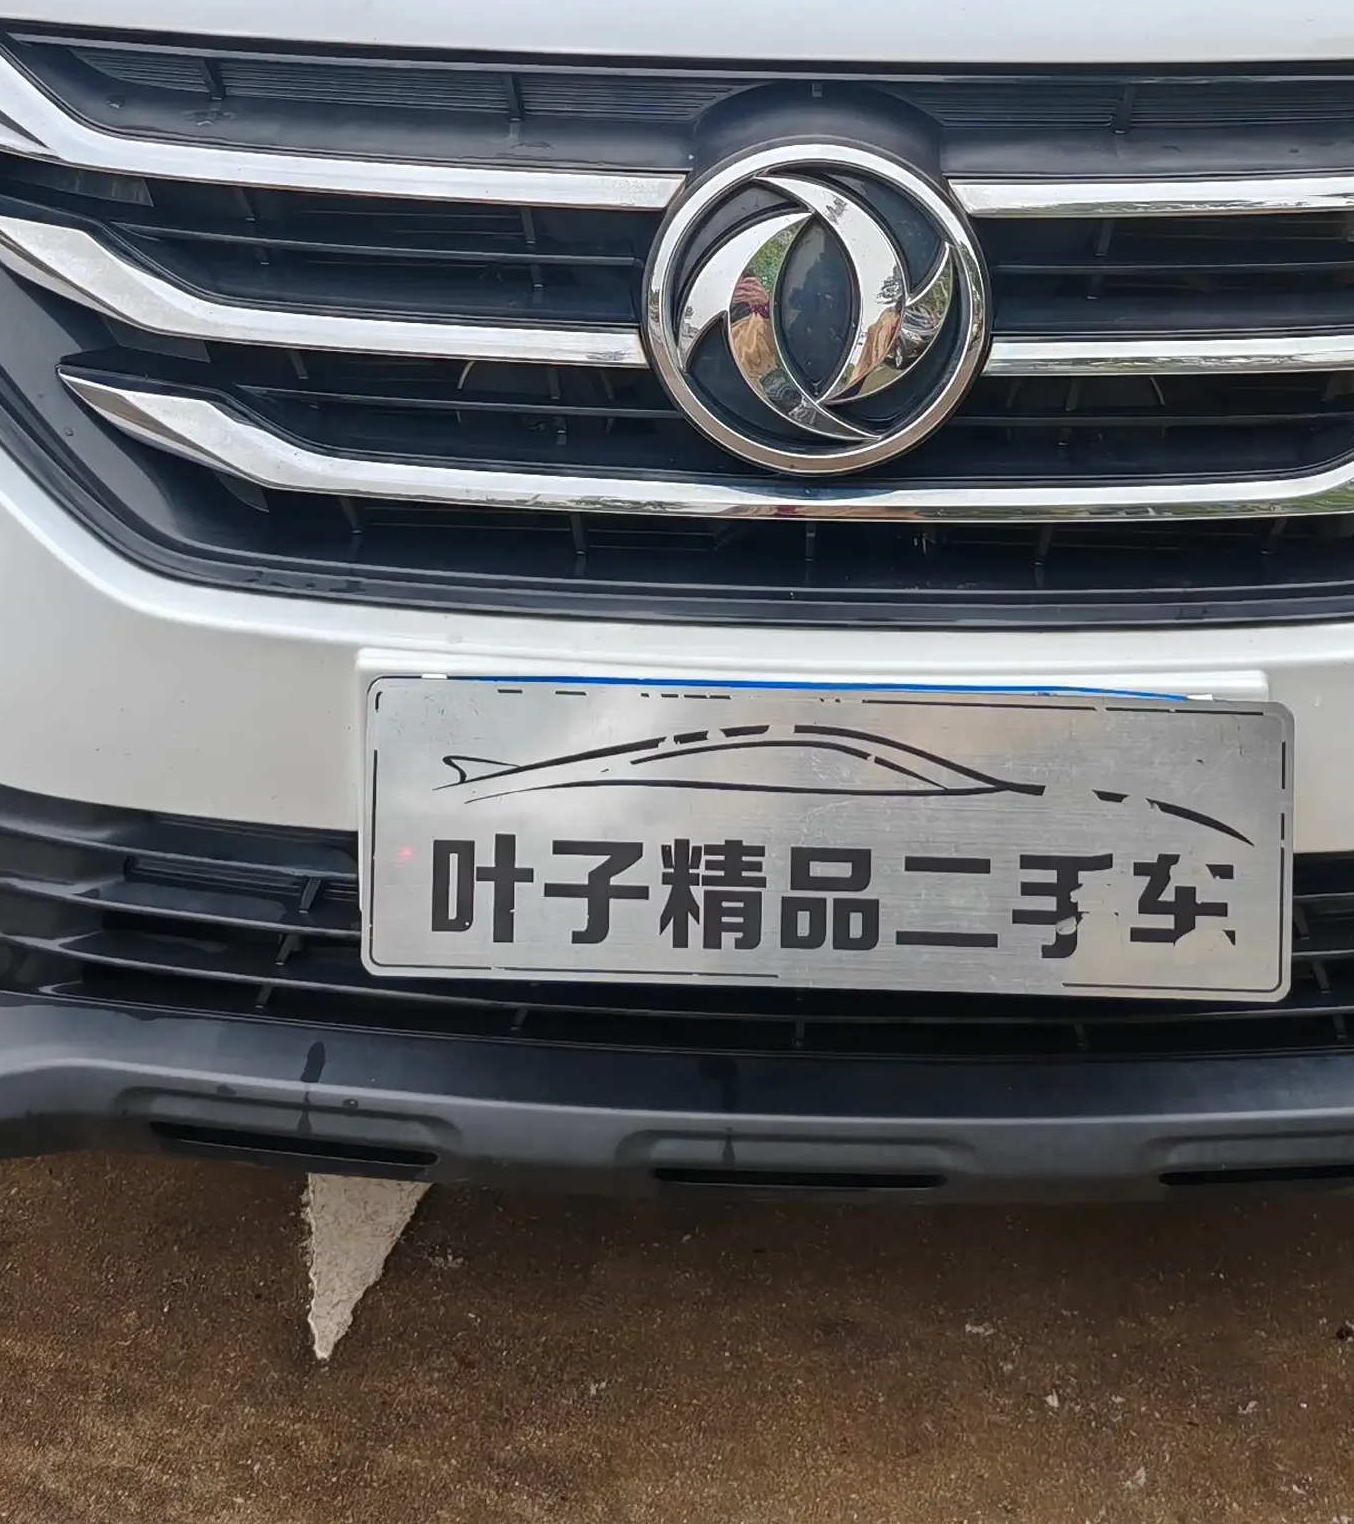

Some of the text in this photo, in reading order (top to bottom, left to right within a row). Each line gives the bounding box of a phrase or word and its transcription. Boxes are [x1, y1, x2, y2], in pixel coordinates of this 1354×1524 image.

[431, 833, 1236, 959] 叶子精品二手车
